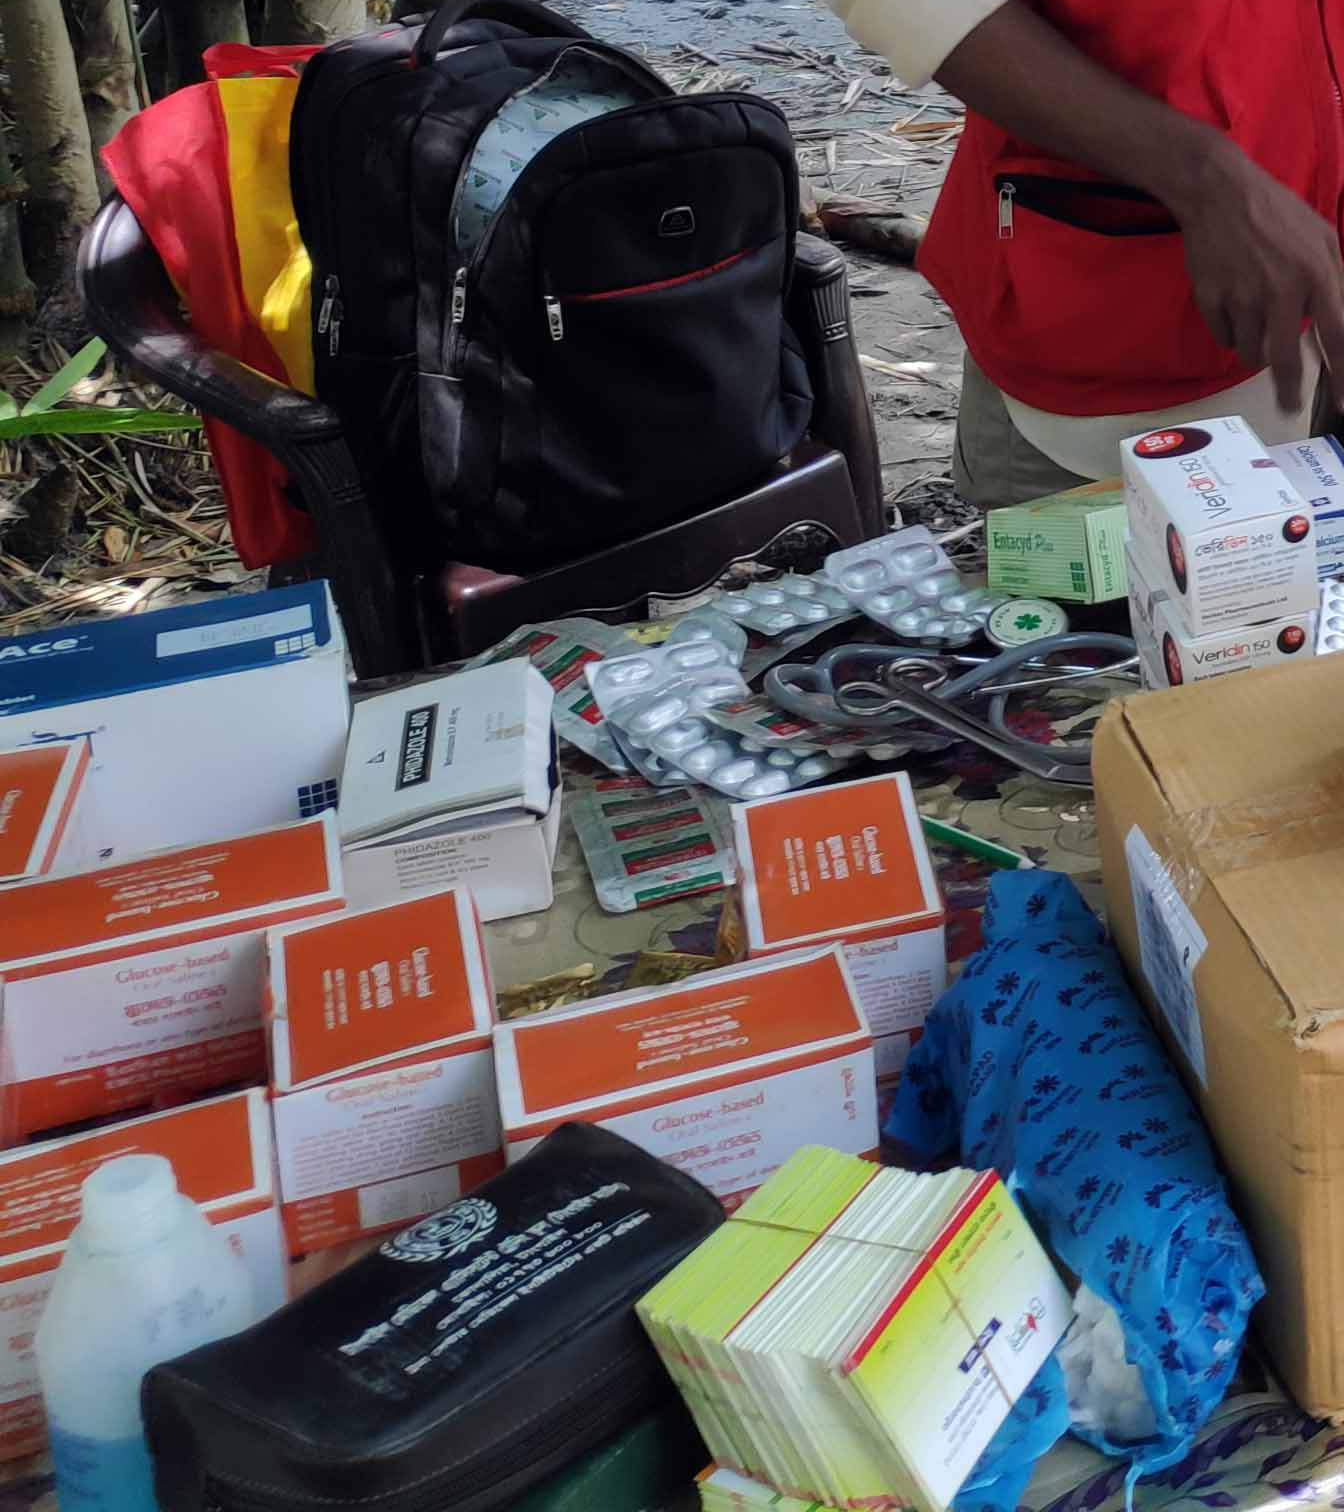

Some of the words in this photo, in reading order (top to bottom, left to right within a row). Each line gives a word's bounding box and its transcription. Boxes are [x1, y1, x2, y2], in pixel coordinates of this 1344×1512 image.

[992, 531, 1033, 557] Entacyd
[0, 638, 80, 660] Ace
[1192, 641, 1251, 666] Veridin
[1252, 639, 1272, 652] 150
[402, 726, 429, 784] PHIDAZOLE
[394, 836, 468, 858] PHIDAZOLE
[115, 946, 231, 985] Glucose-based
[651, 1090, 766, 1133] Glucose-based
